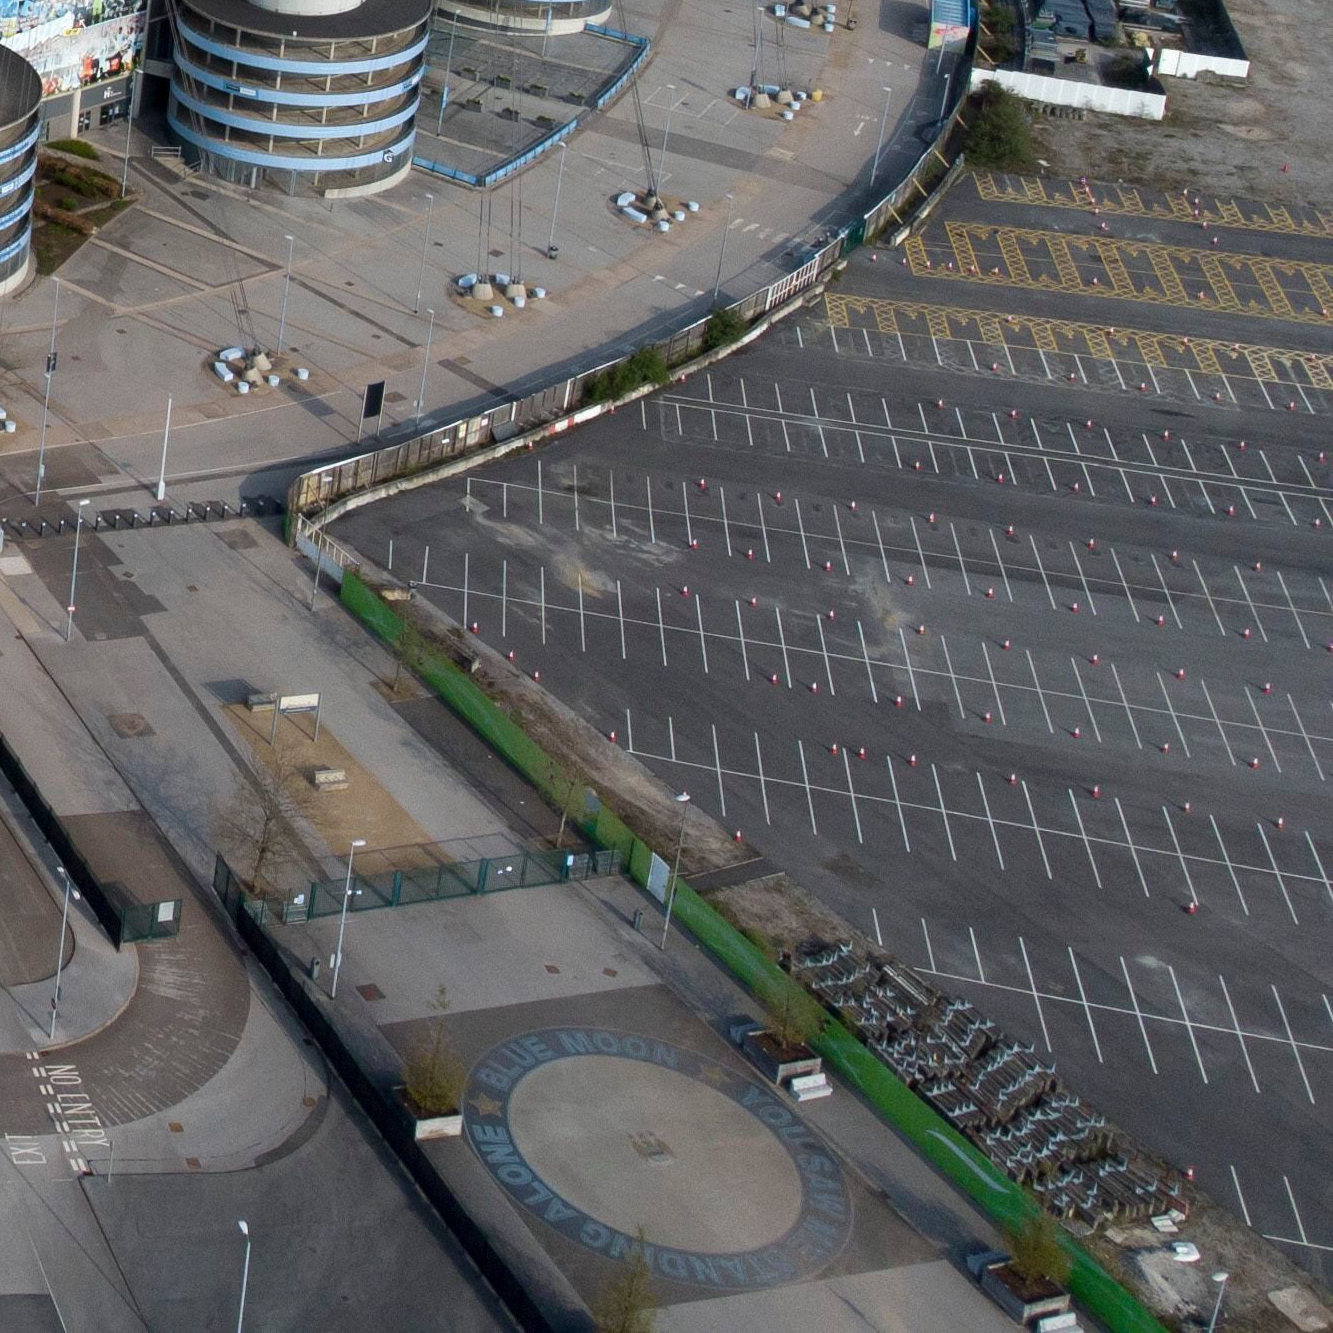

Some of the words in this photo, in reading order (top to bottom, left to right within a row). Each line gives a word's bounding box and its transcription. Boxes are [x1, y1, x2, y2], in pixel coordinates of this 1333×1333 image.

[477, 1035, 555, 1090] BLUE
[559, 1030, 679, 1069] MOON
[44, 1065, 82, 1085] NO
[56, 1093, 110, 1147] ENTRY
[4, 1132, 47, 1165] EXIT
[472, 1123, 579, 1225] ALONE
